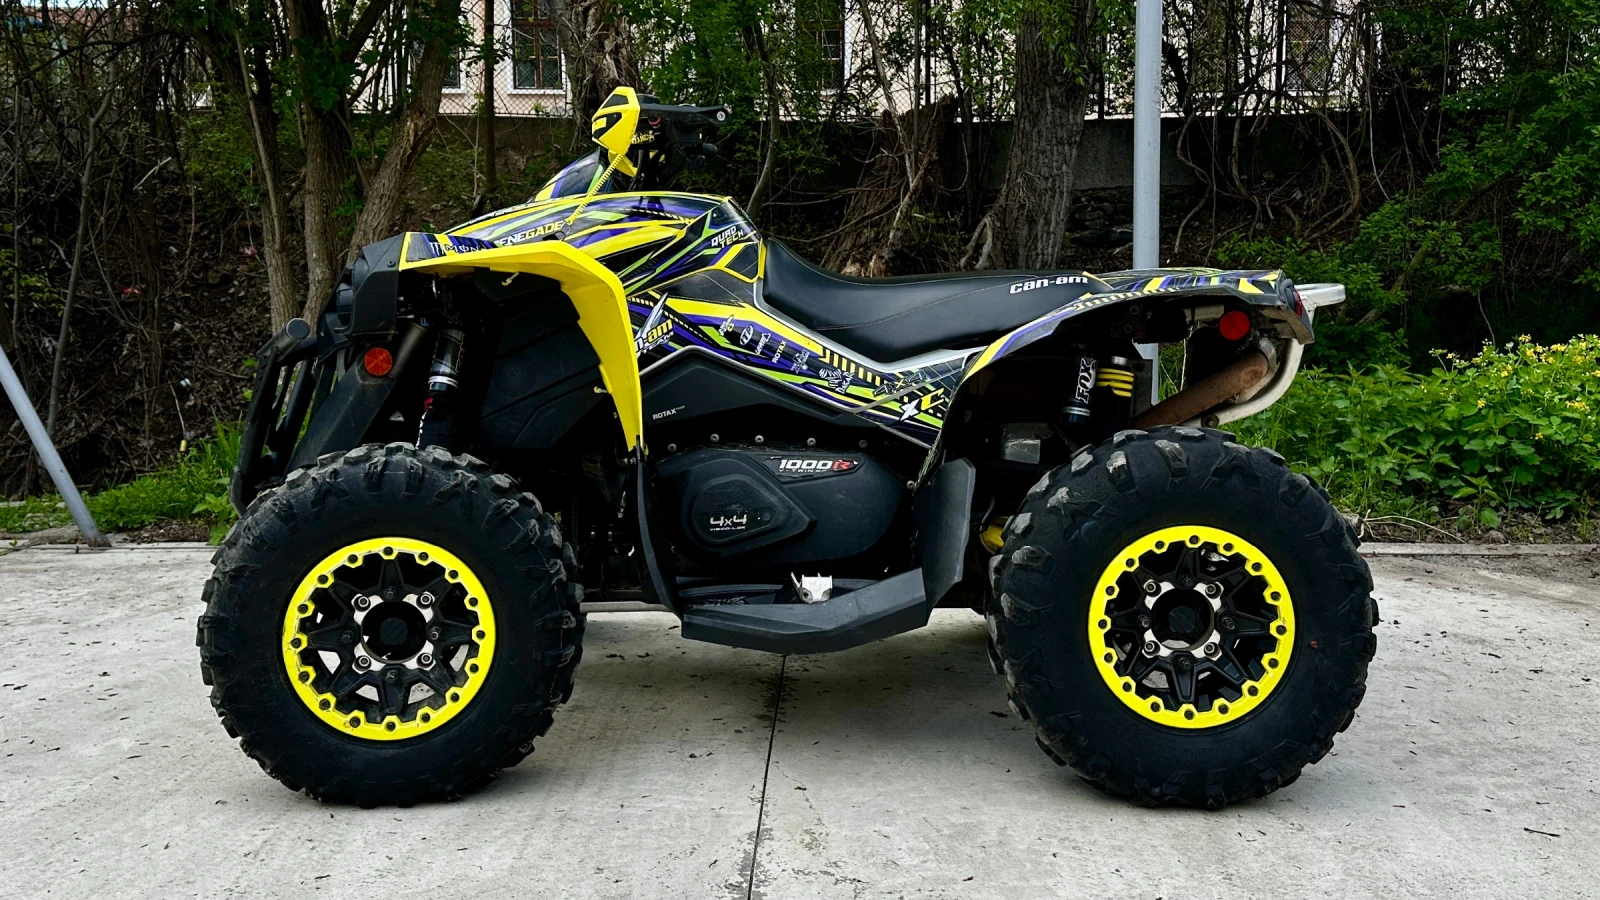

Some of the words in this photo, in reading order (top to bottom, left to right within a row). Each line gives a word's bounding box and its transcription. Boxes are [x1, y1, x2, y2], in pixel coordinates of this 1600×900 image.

[493, 220, 564, 246] ENEGADE
[711, 226, 737, 246] QUAD
[720, 229, 744, 248] TECH
[1009, 276, 1088, 294] can-am
[772, 340, 787, 364] ROTAX
[1075, 357, 1096, 404] FOX
[652, 408, 677, 420] ROTAX
[709, 514, 748, 526] 4x4
